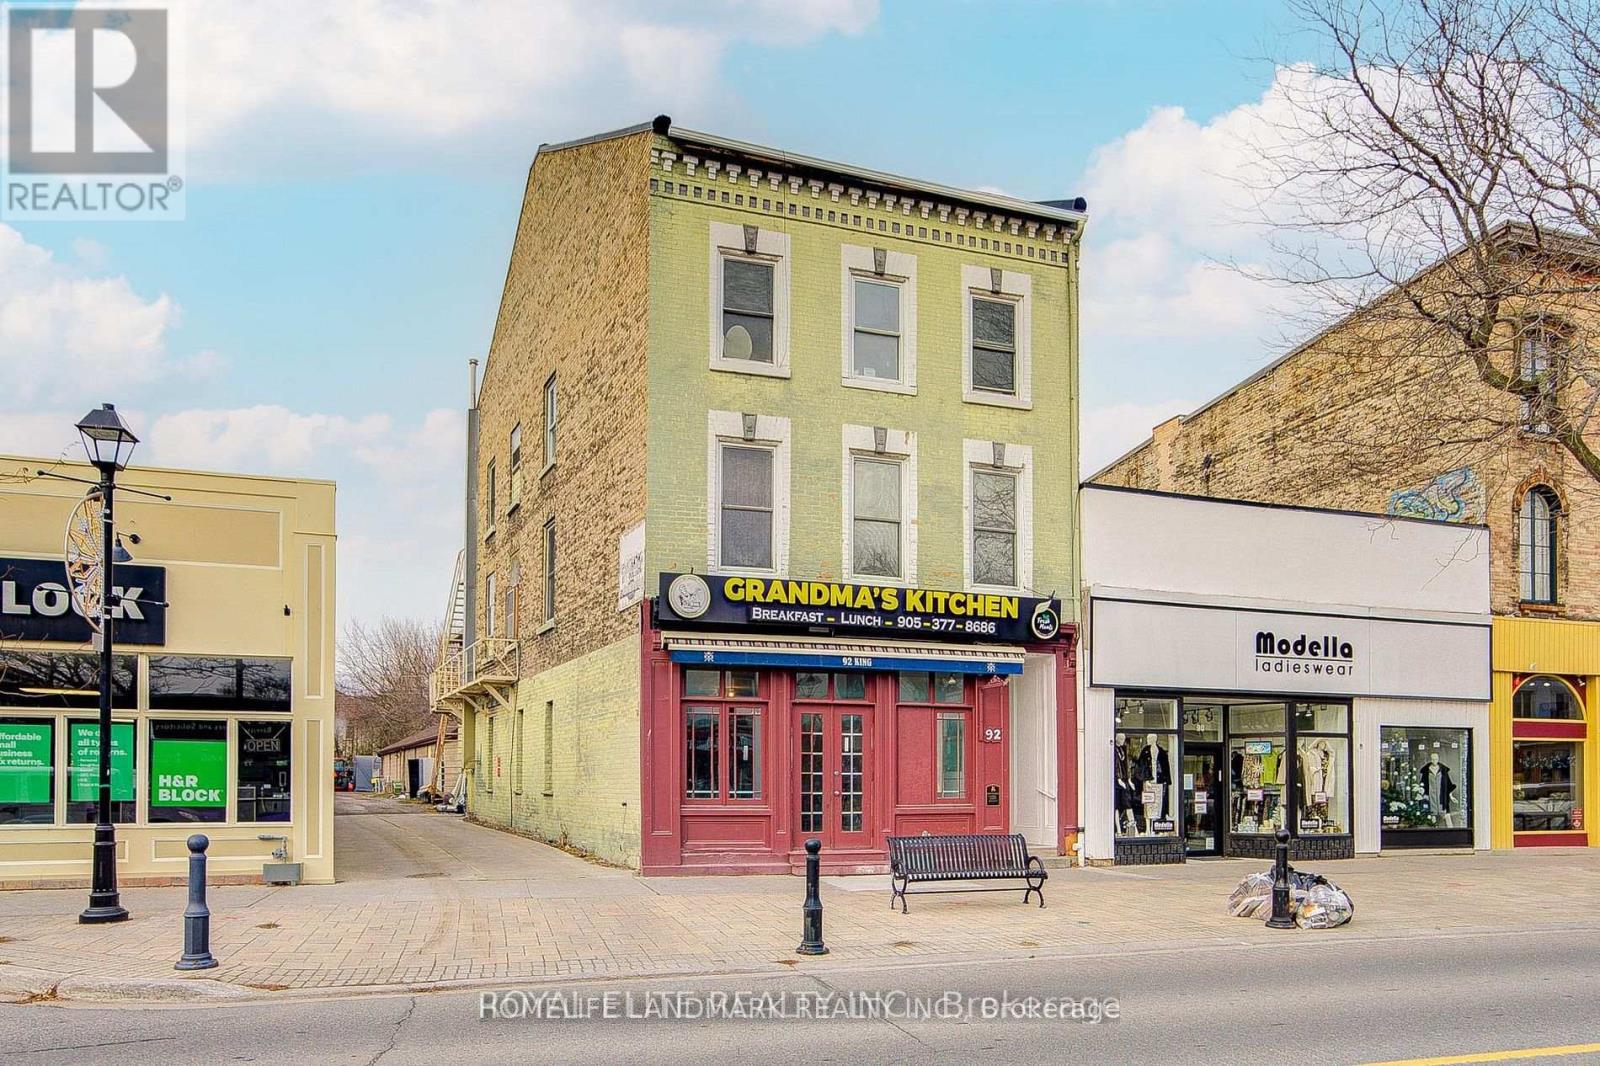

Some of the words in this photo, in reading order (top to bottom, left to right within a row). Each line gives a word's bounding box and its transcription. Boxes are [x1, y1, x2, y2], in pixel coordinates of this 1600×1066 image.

[724, 577, 899, 611] GRANDMA'S
[905, 588, 1019, 619] KITCHEN
[752, 607, 824, 623] BREAKFAST
[841, 612, 881, 627] LUNCH
[1255, 631, 1353, 658] Modella
[842, 657, 853, 666] 92
[854, 657, 872, 667] KING
[1255, 658, 1353, 676] ladieswear
[985, 729, 1001, 740] 92
[77, 738, 90, 747] all
[246, 739, 280, 752] OPEN
[158, 774, 198, 787] H&R
[158, 789, 221, 801] BLOCK
